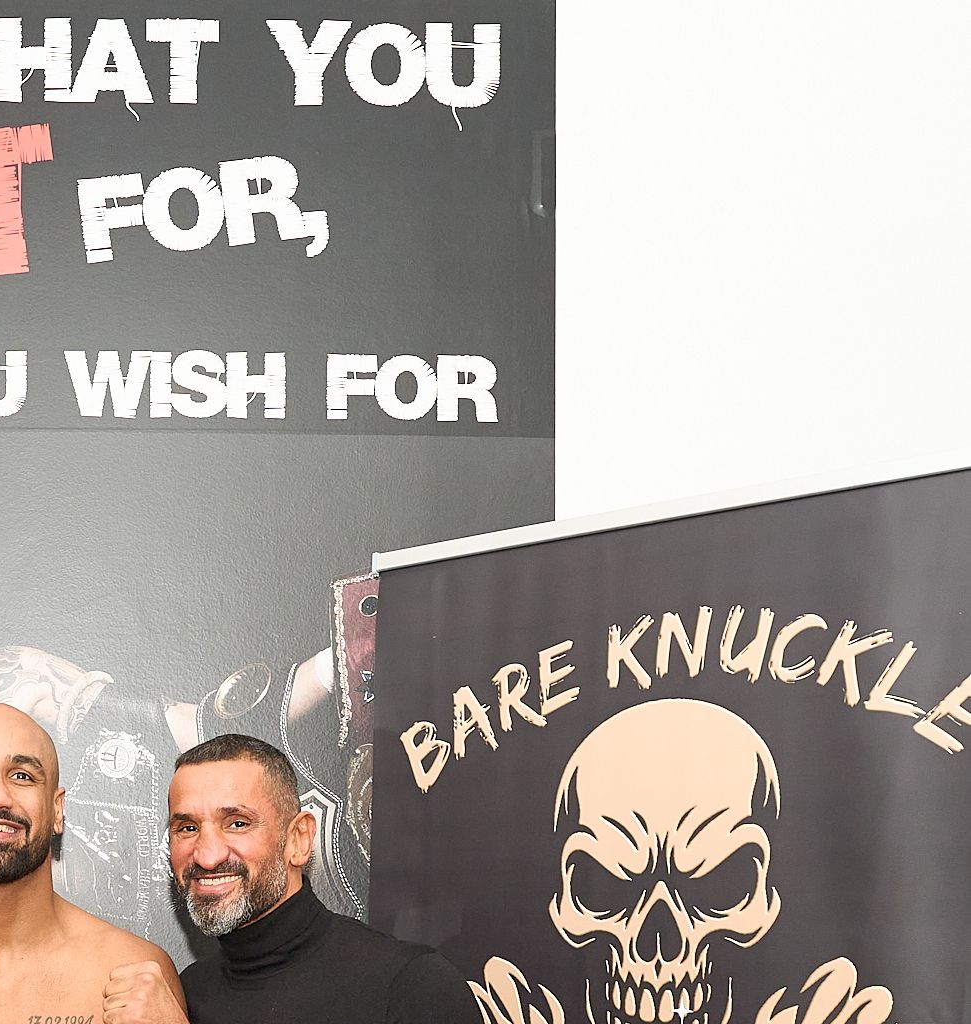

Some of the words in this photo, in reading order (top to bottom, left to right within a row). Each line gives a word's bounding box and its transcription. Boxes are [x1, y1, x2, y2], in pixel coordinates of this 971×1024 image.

[266, 19, 501, 130] YOU
[77, 155, 330, 264] FOR,
[64, 350, 286, 418] WISH
[326, 354, 498, 422] FOR
[400, 639, 581, 793] BARE
[606, 605, 971, 755] KNUCKLE
[136, 817, 150, 858] WORLD
